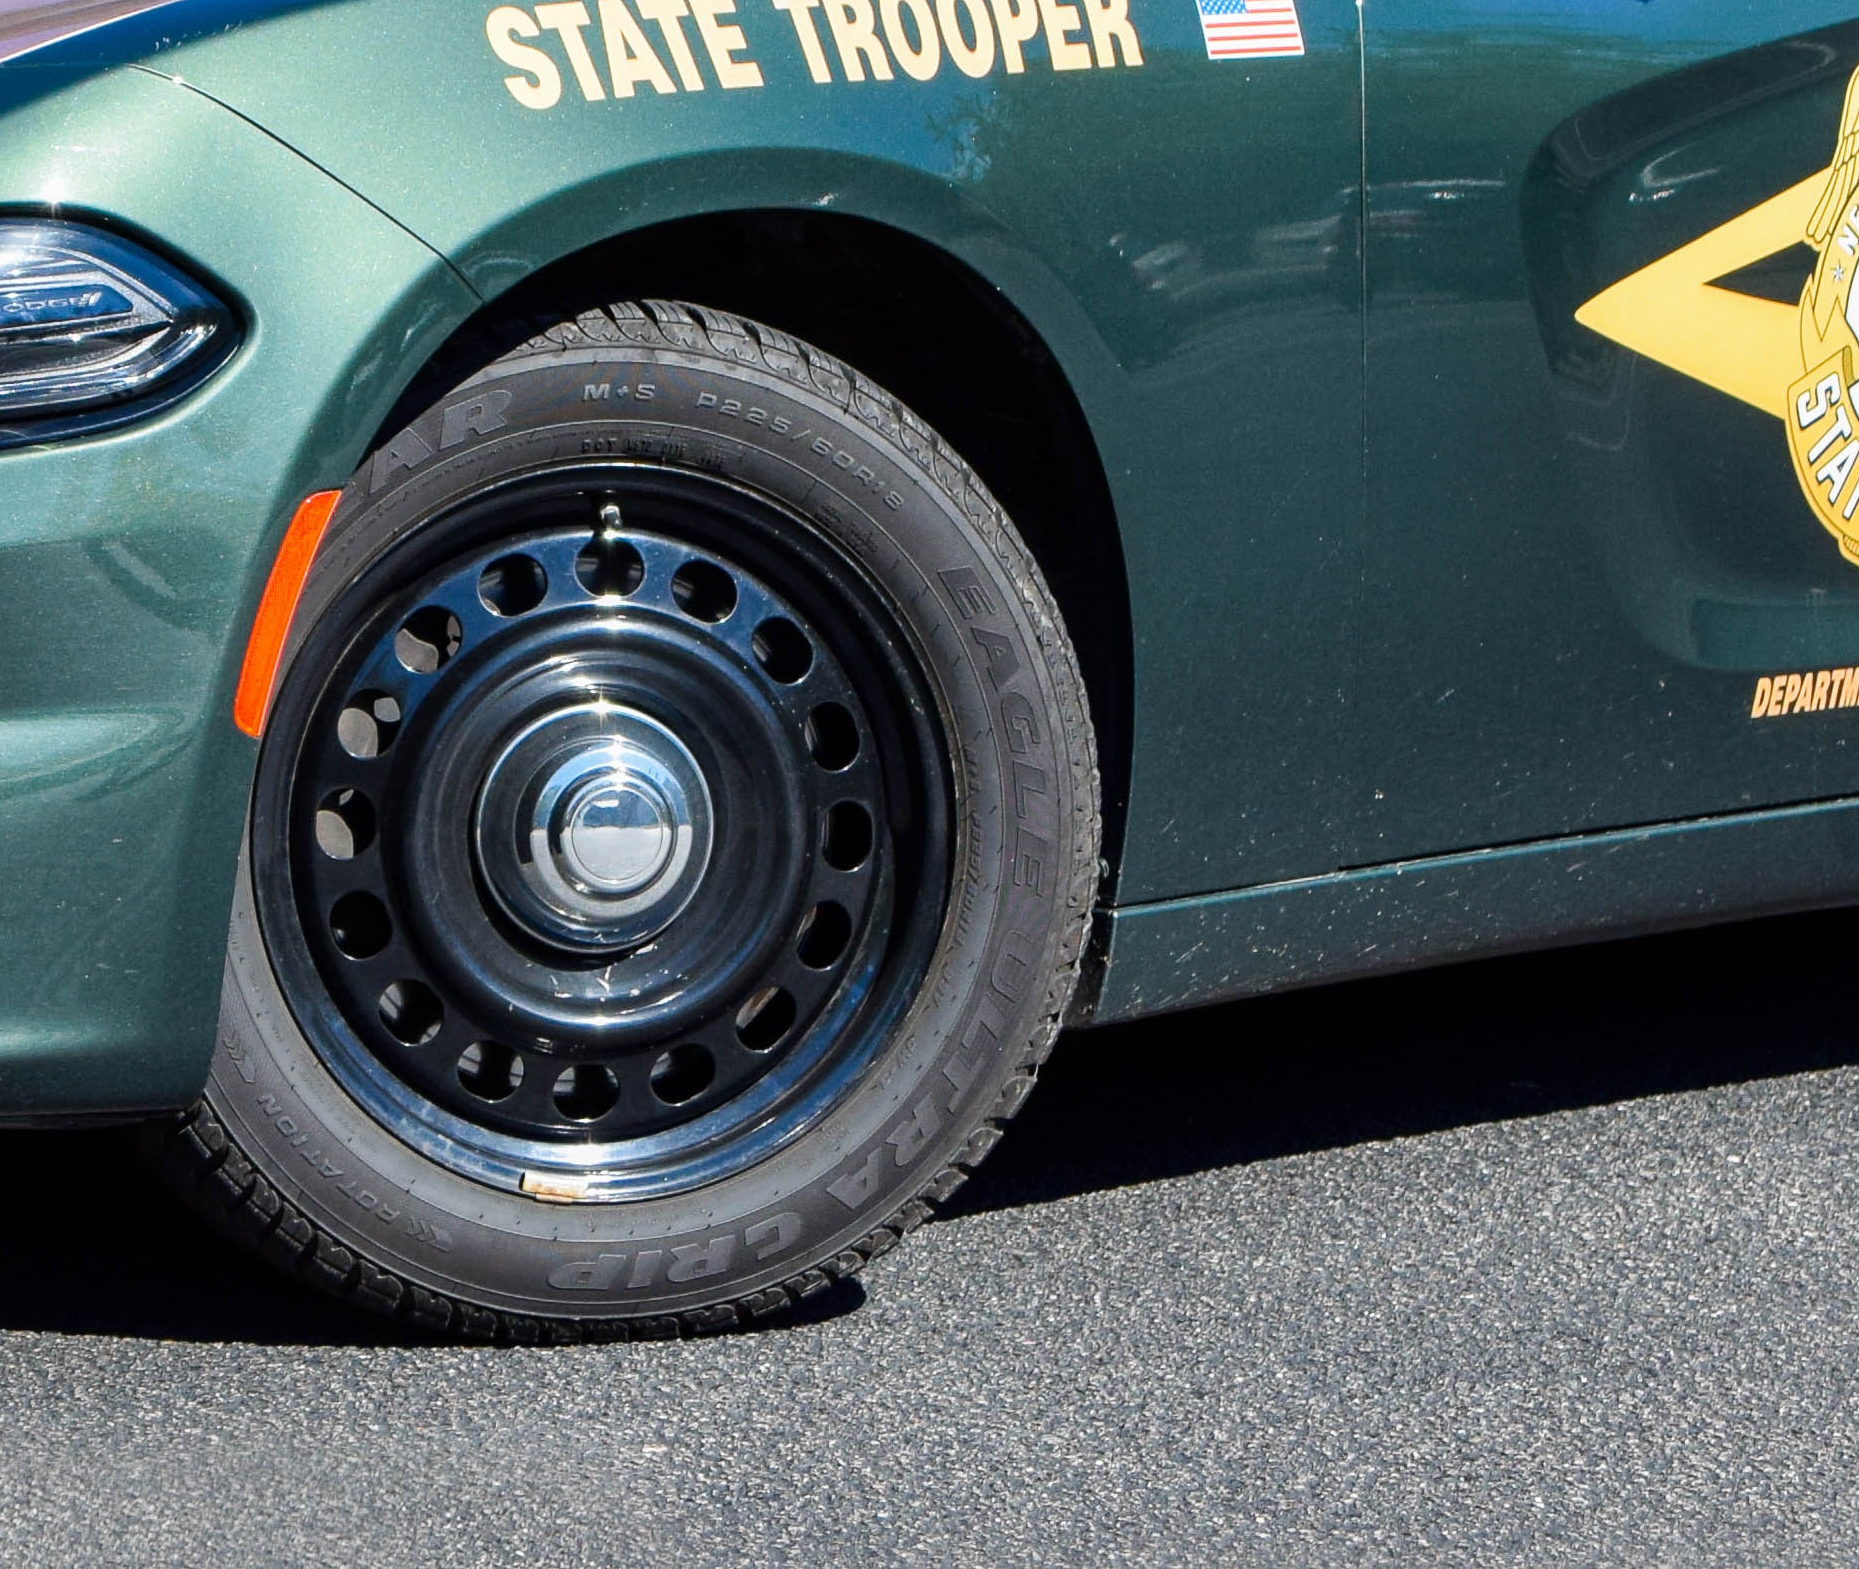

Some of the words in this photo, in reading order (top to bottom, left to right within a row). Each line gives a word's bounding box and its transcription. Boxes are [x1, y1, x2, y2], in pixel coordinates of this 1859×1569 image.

[695, 390, 905, 512] P225/60R18
[937, 565, 1047, 897] EAGLE
[257, 1094, 401, 1224] ROTATION
[547, 1211, 803, 1290] GRIP
